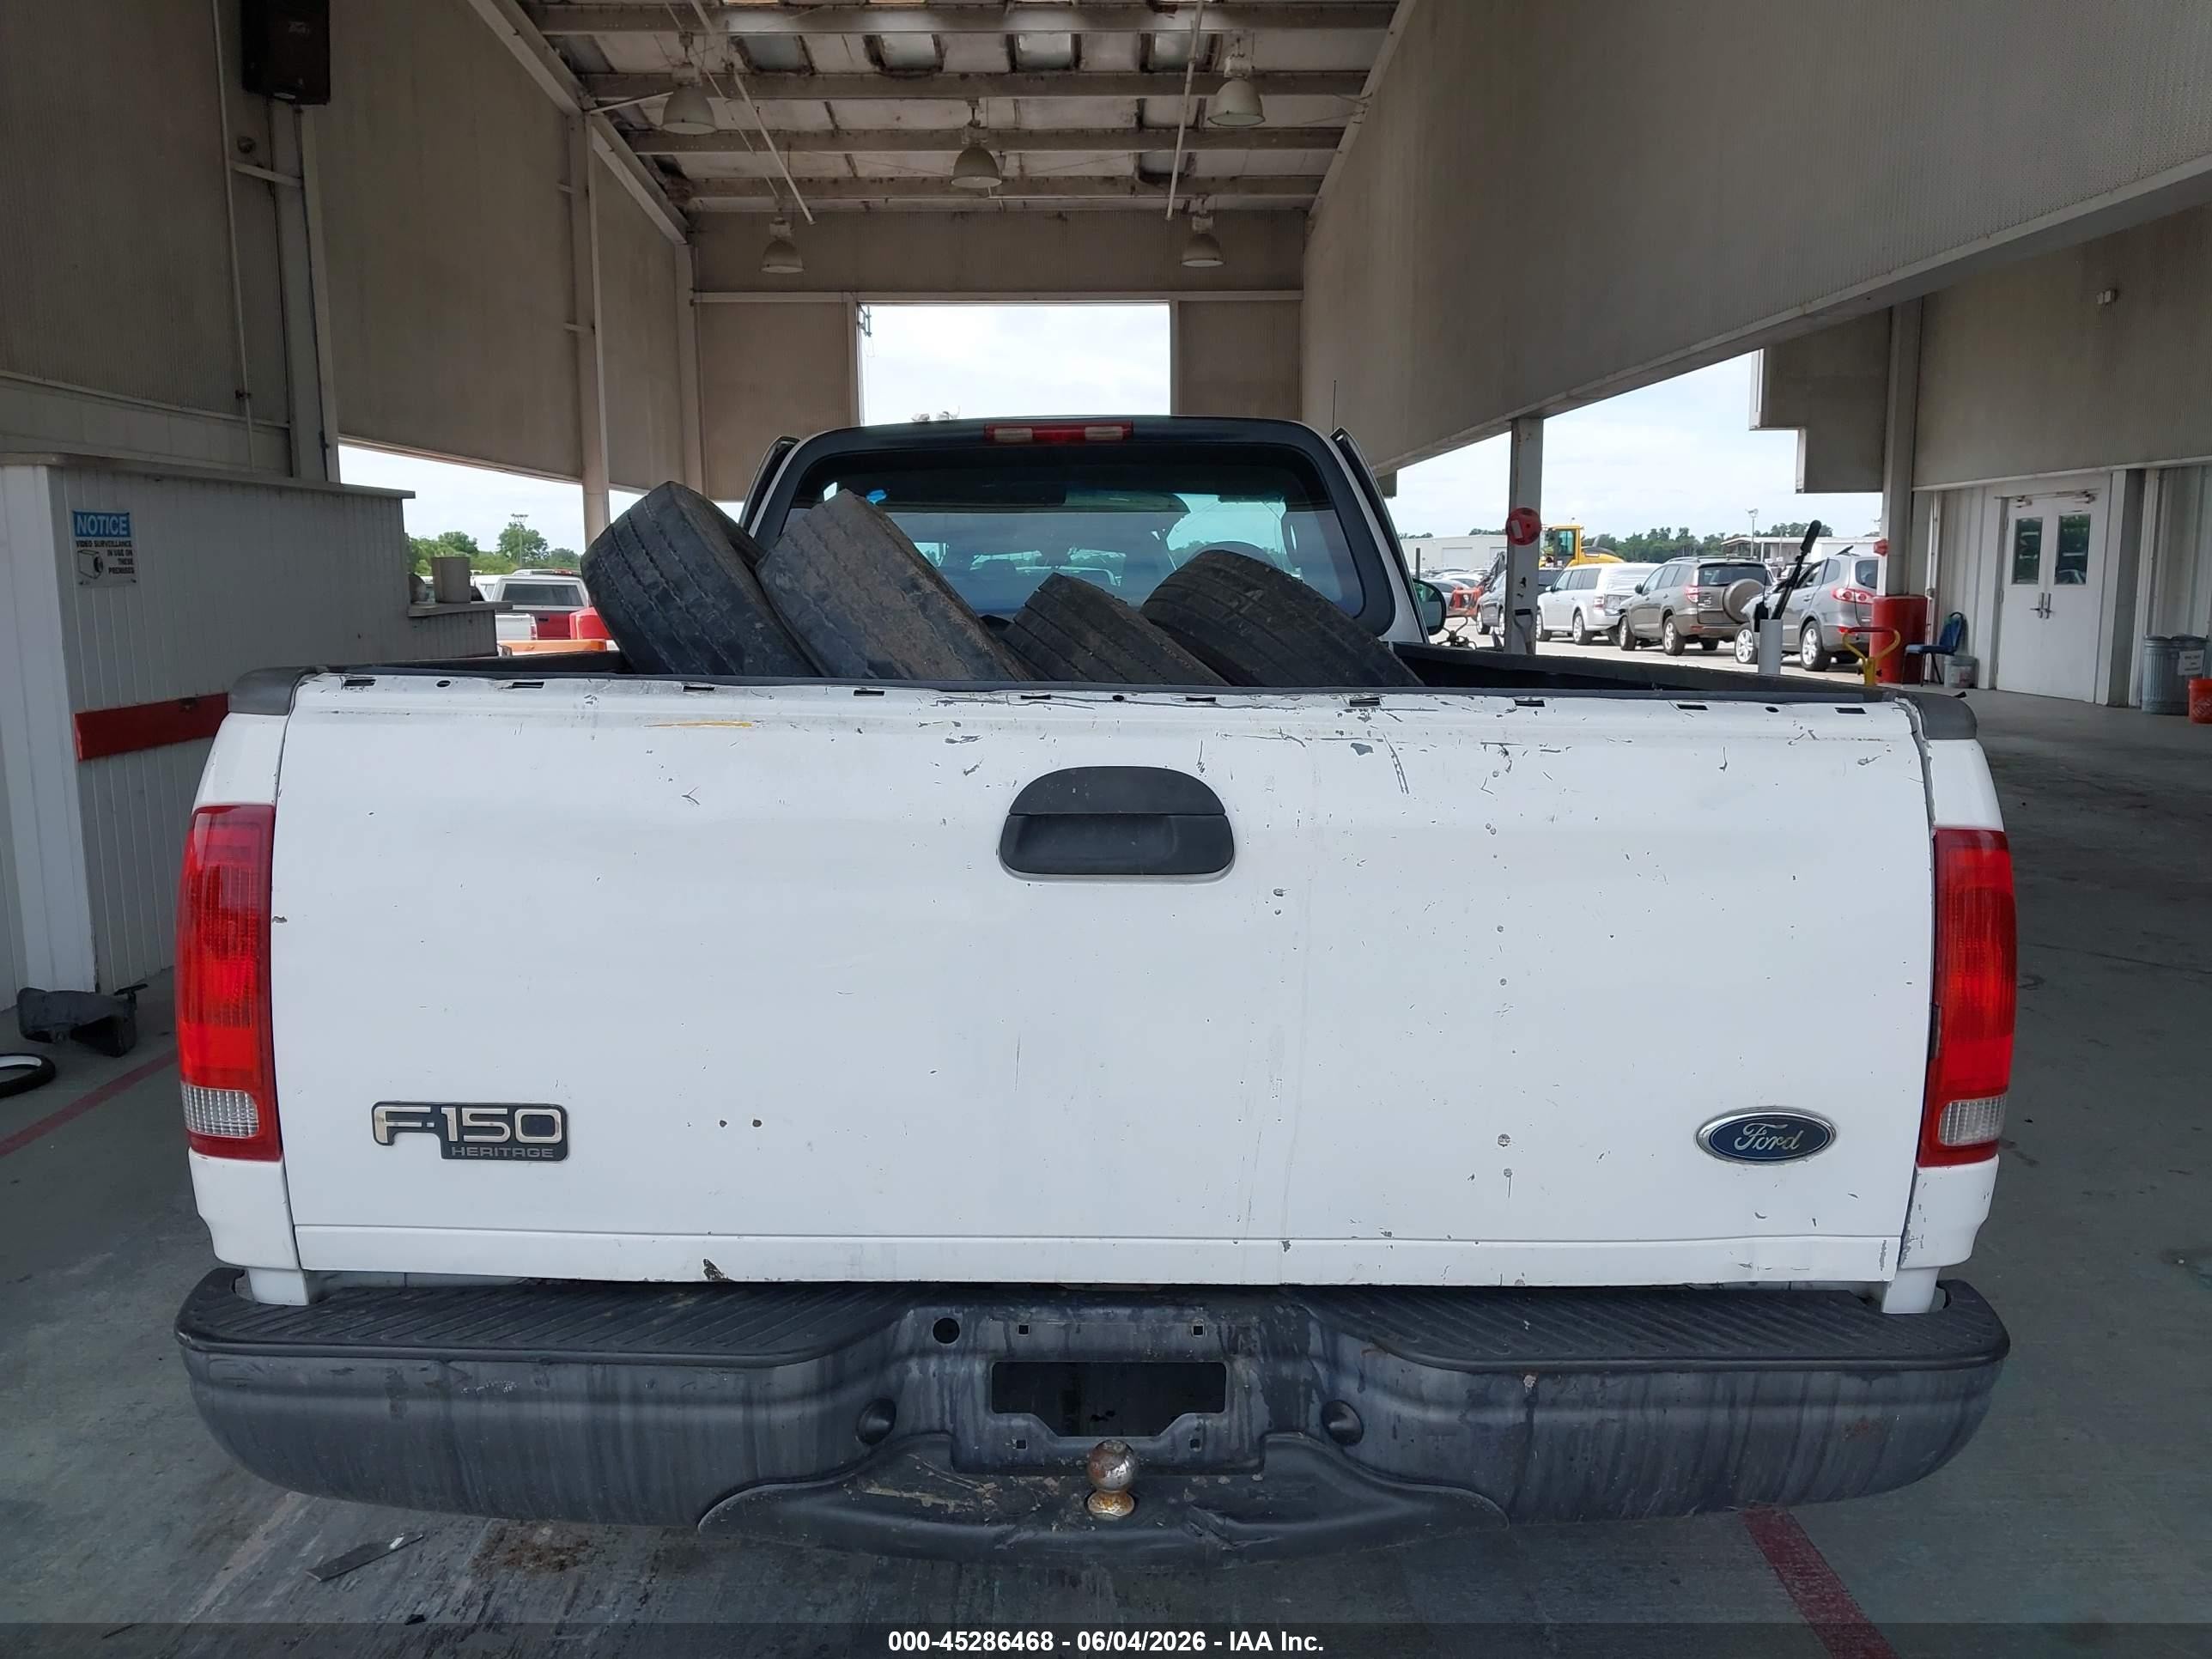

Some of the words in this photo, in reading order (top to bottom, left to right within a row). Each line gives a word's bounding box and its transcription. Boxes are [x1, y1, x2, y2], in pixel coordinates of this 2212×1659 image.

[76, 514, 128, 535] NOTICE
[374, 1106, 563, 1144] F-150
[1734, 1122, 1804, 1151] Ford
[452, 1146, 555, 1158] HERITAGE
